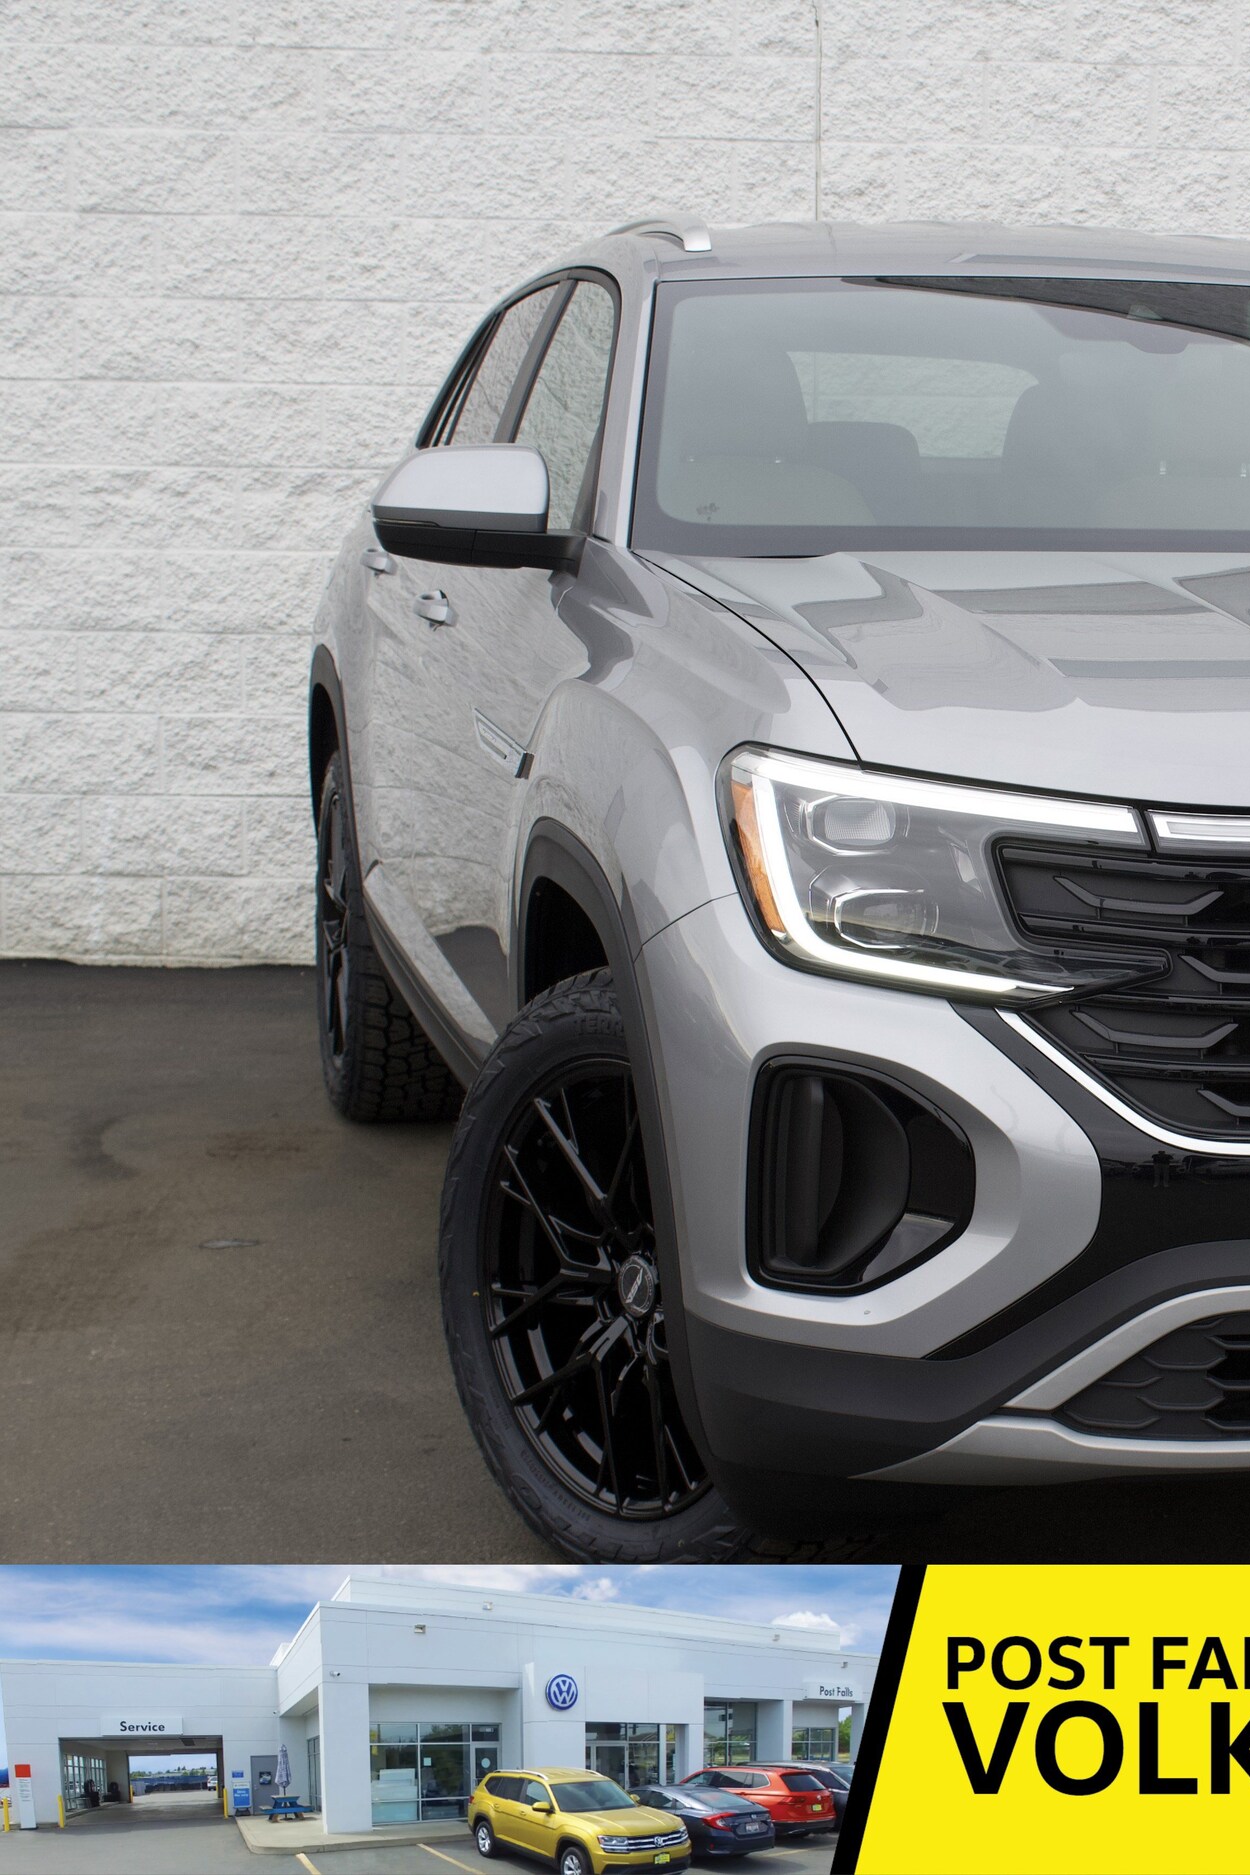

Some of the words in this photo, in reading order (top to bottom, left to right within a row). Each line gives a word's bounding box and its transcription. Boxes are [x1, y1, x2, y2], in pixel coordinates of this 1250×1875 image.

[820, 1686, 835, 1696] Post
[836, 1687, 853, 1697] Falls
[119, 1720, 166, 1732] Service
